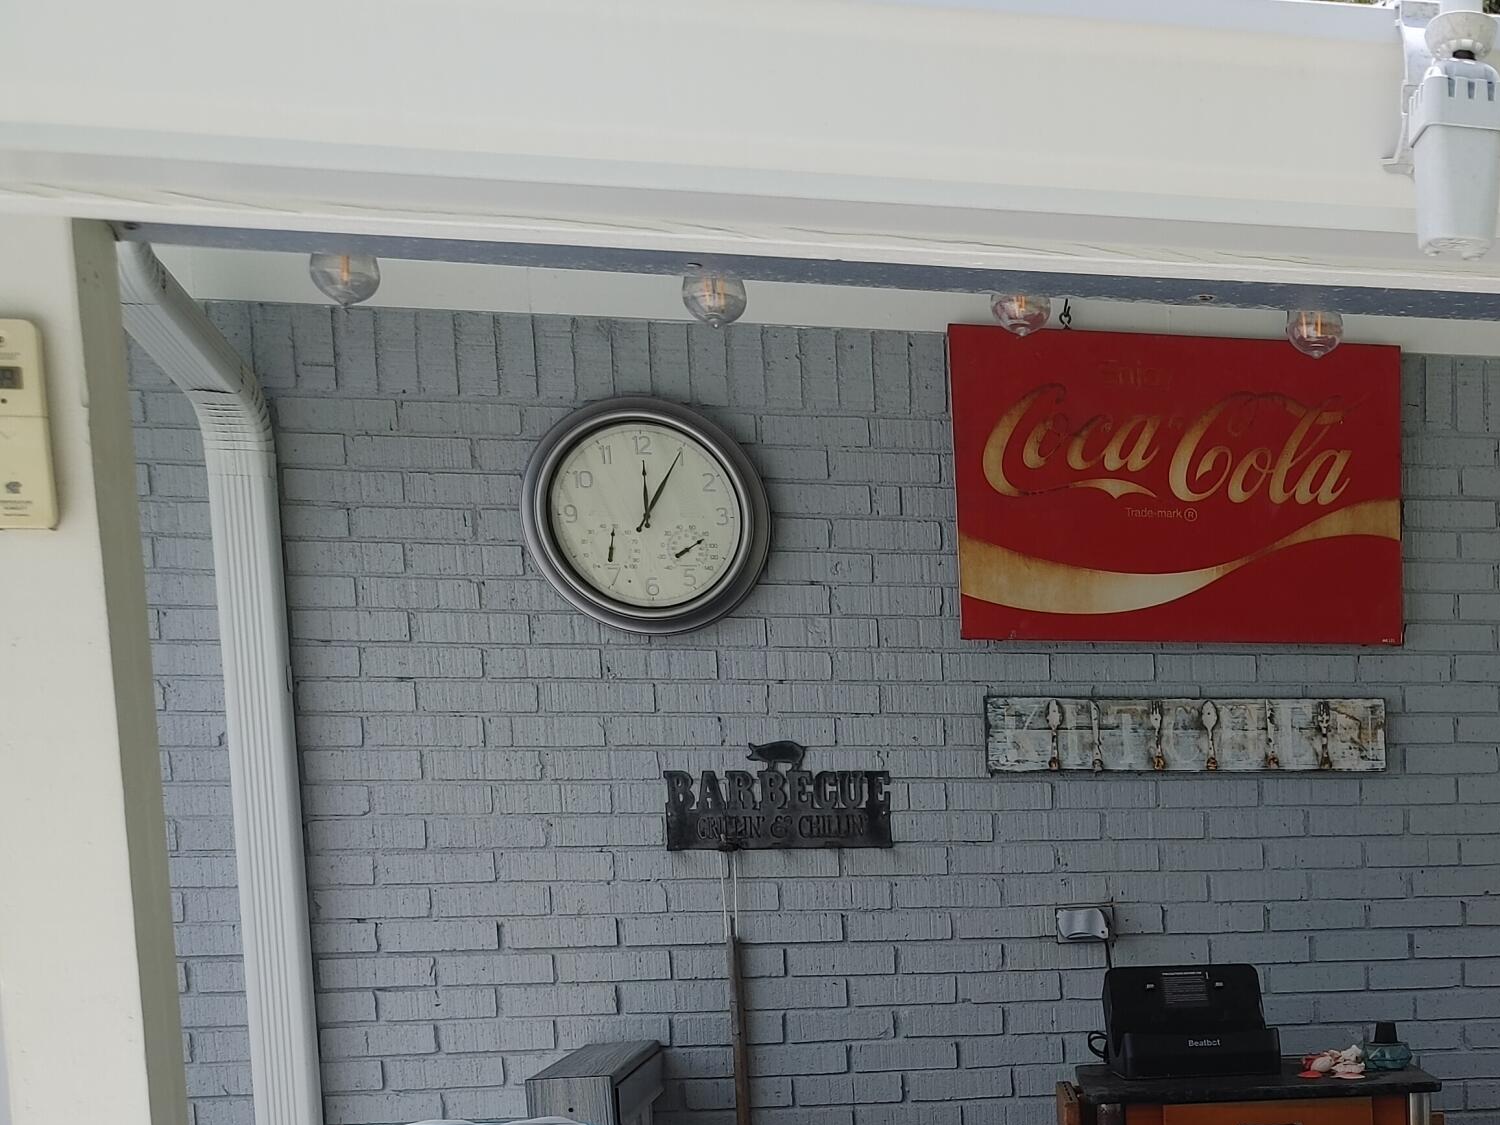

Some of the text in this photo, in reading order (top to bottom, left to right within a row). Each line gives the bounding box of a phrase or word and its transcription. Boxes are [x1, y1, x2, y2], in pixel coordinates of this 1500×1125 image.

[598, 445, 612, 465] 11
[632, 435, 652, 455] 12
[572, 470, 594, 489] 10
[702, 473, 717, 493] 2
[563, 504, 578, 524] 9
[715, 507, 729, 526] 3
[645, 577, 660, 596] 6
[683, 568, 697, 587] 5
[663, 770, 890, 811] BARBECUE
[771, 816, 793, 838] &
